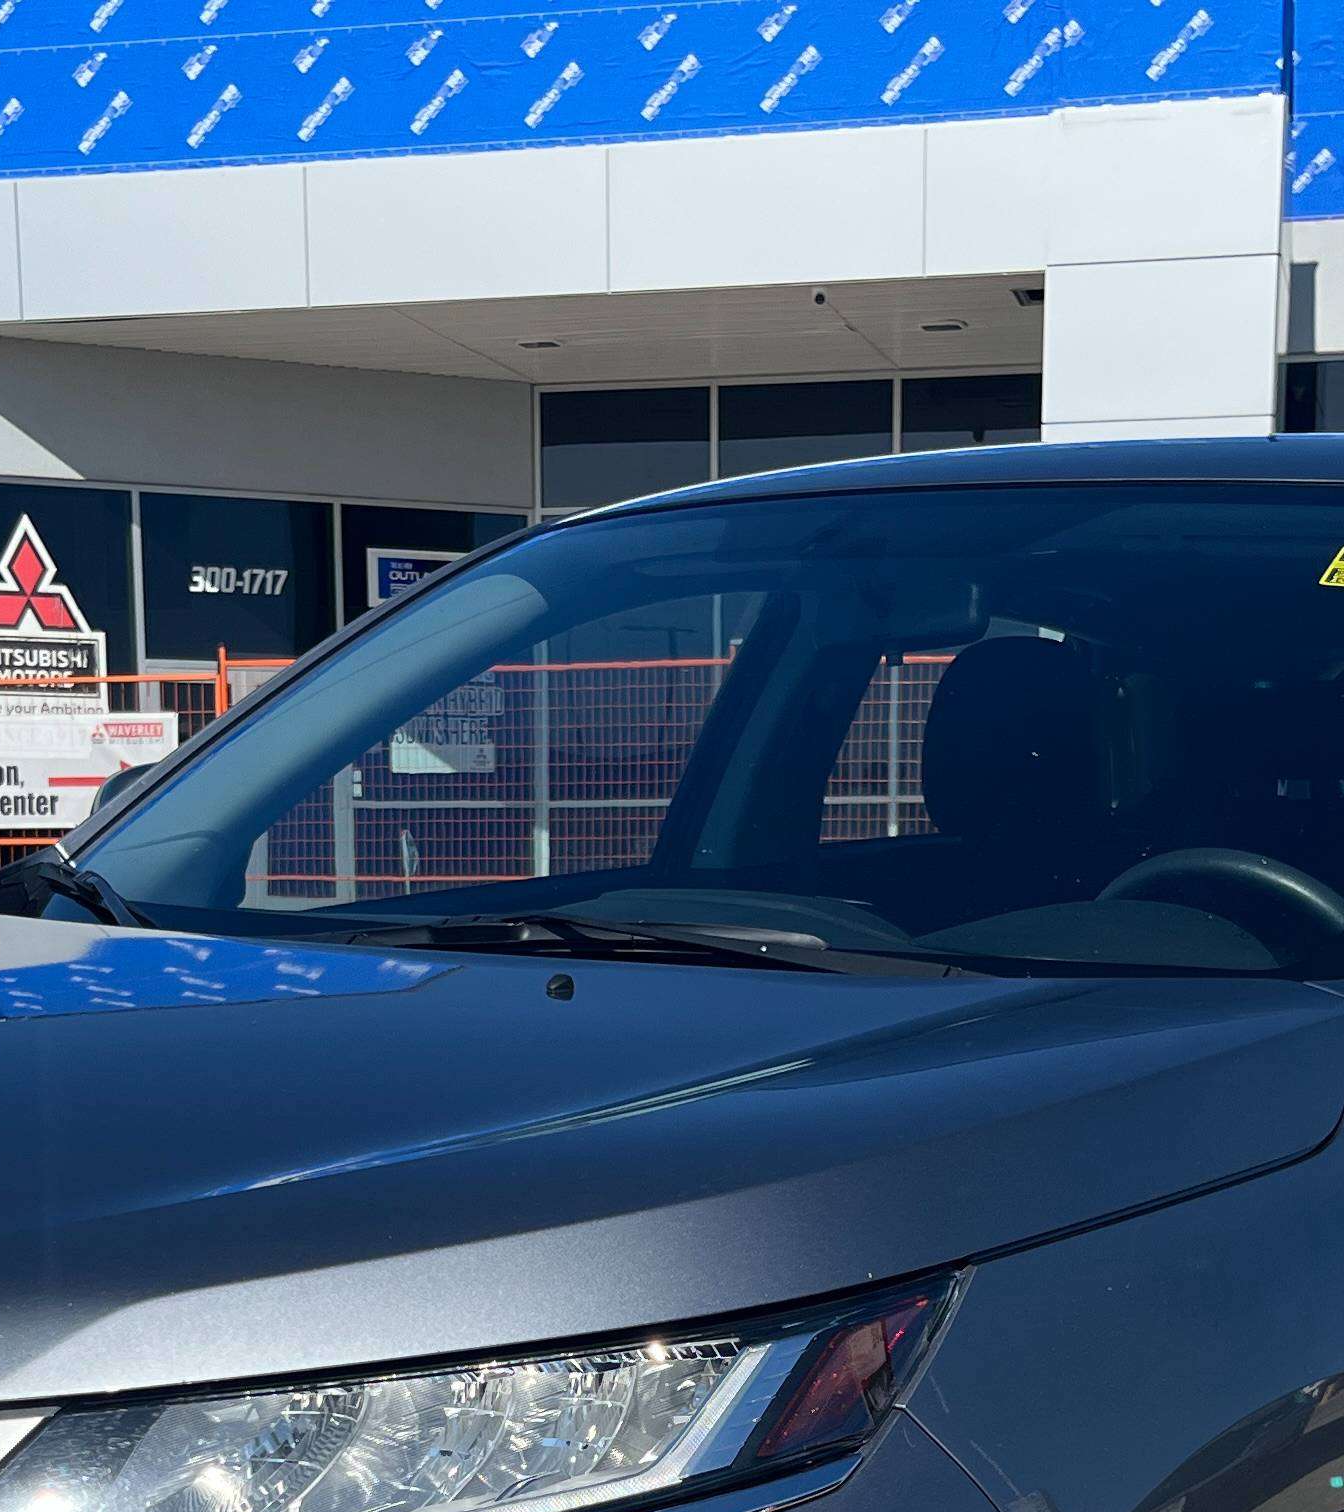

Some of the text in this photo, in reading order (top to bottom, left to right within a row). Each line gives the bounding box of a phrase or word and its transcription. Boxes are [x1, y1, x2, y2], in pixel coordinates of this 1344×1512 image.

[189, 566, 289, 595] 300-1717
[7, 703, 37, 716] your
[40, 702, 104, 716] Ambition
[107, 724, 163, 737] WAVERLEY
